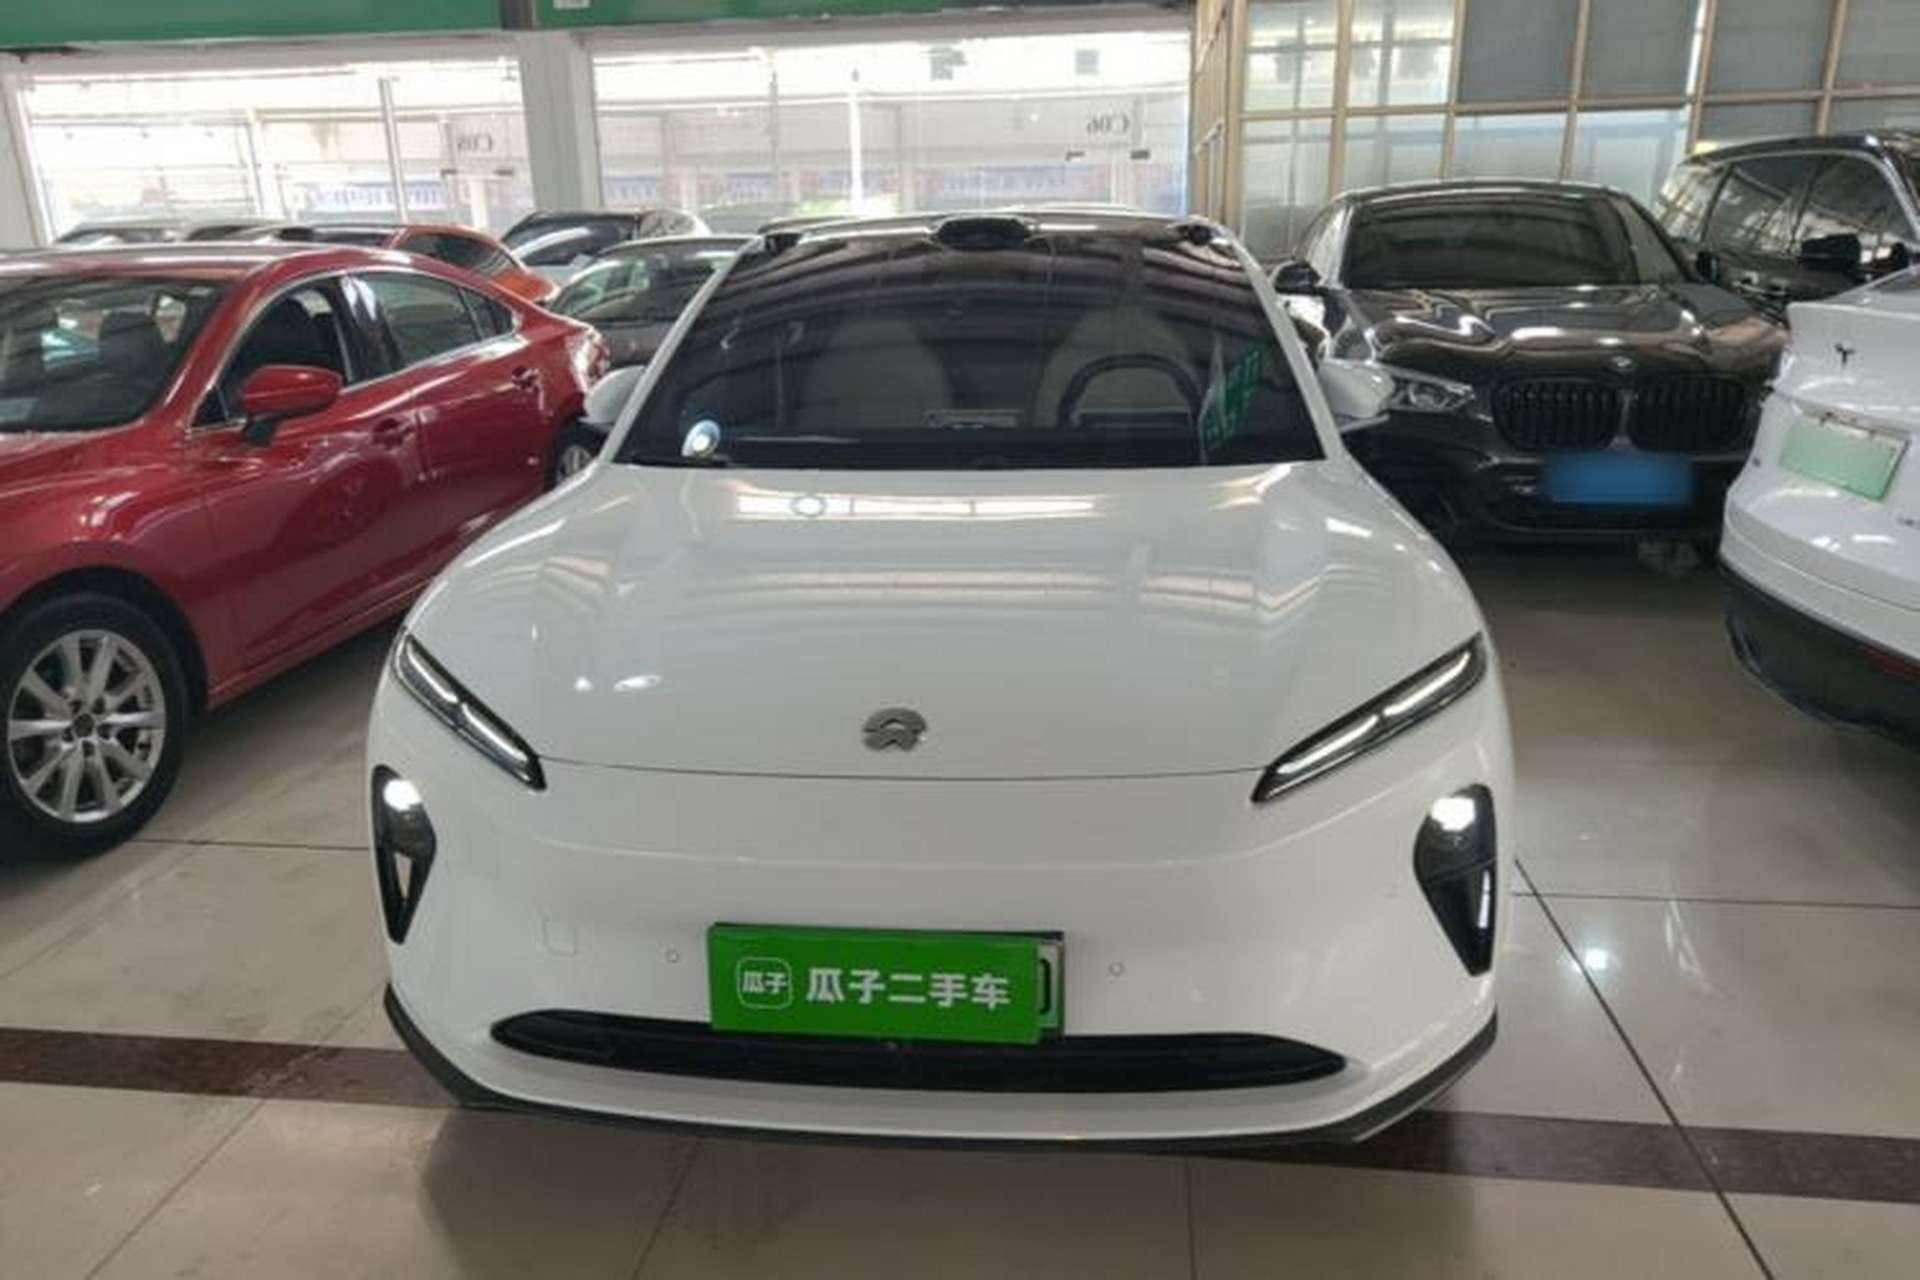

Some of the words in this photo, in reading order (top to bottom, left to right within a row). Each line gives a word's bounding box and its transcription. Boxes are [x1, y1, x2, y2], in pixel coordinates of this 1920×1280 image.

[742, 970, 788, 994] 瓜子
[806, 967, 1012, 1009] 瓜子二手车
